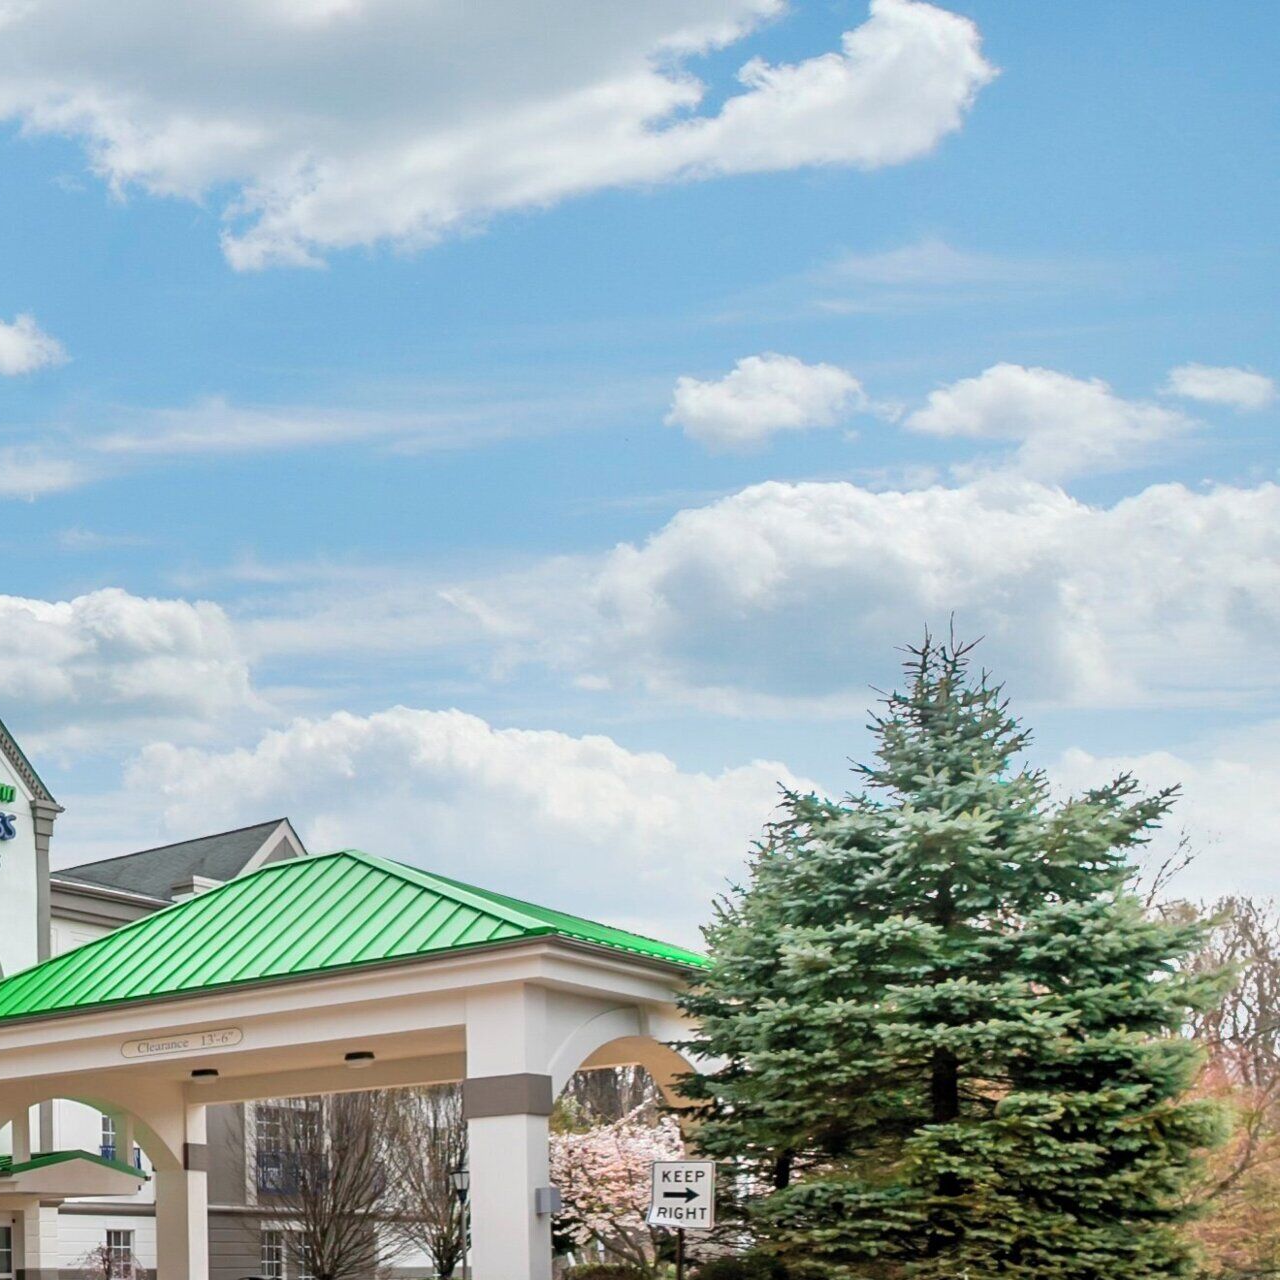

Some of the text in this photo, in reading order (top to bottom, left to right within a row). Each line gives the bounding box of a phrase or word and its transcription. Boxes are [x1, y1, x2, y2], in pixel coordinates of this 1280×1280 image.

[137, 1040, 189, 1054] Clearance
[661, 1170, 706, 1183] KEEP
[656, 1206, 708, 1220] RIGHT
